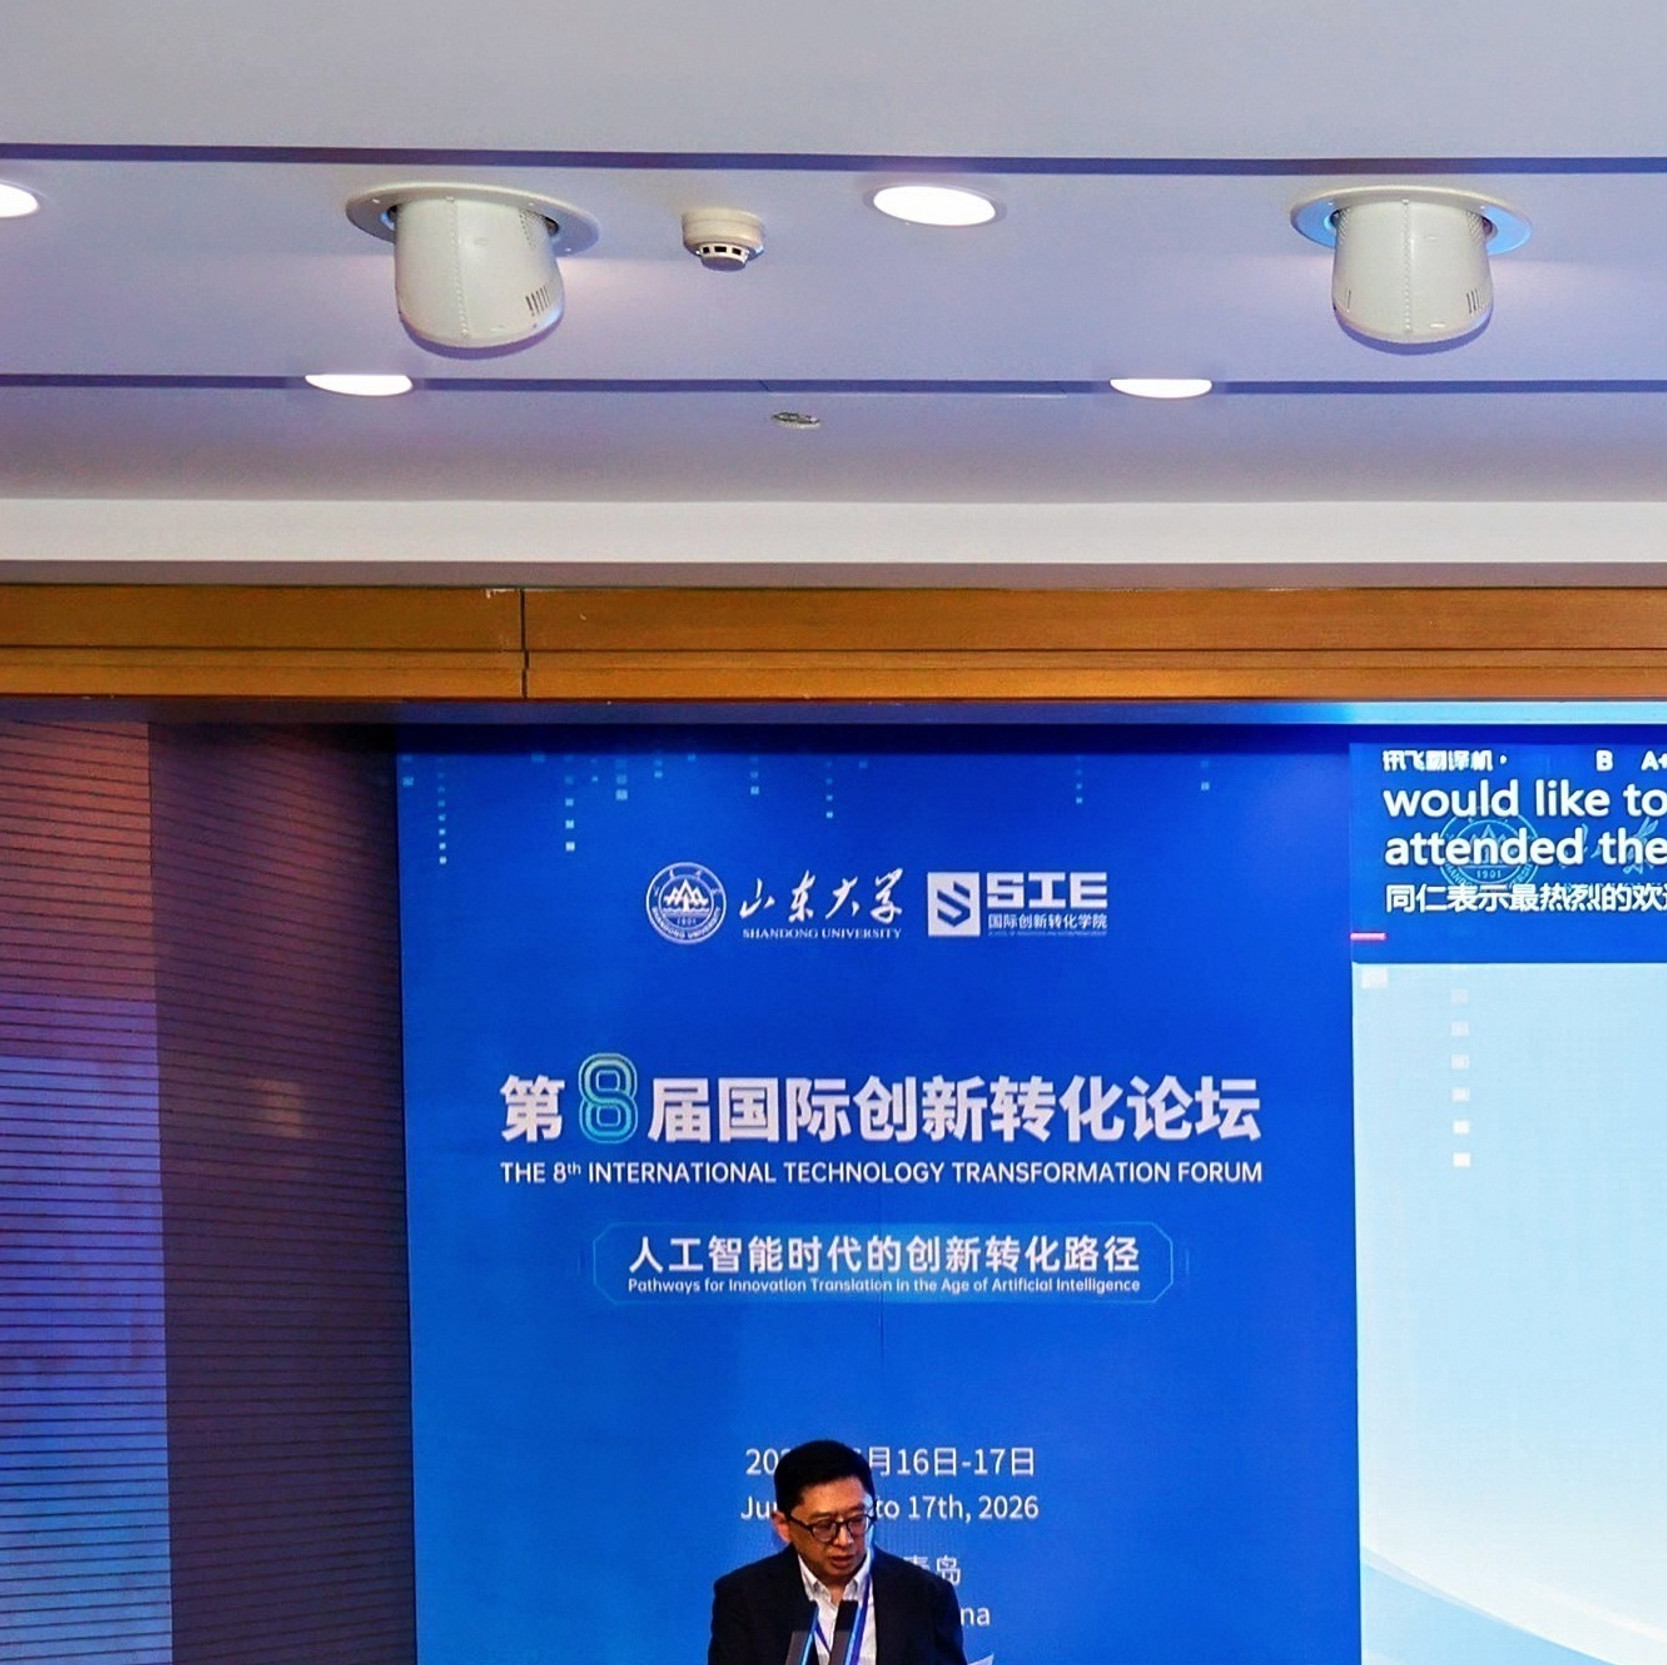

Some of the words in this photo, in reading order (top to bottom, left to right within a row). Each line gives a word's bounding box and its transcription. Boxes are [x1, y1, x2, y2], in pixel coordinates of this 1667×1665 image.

[1597, 750, 1613, 771] B
[1384, 780, 1517, 816] would
[1537, 781, 1609, 815] like
[1386, 828, 1582, 864] attended
[987, 873, 1107, 908] SIE
[989, 914, 1107, 928] 国际创新转化学院
[743, 928, 818, 939] SHANDONG
[822, 928, 901, 939] UNIVERSITY
[501, 1163, 544, 1182] THE
[554, 1163, 580, 1182] 8th
[589, 1163, 776, 1182] INTERNATIONAL
[784, 1162, 944, 1182] TECHNOLOGY
[952, 1162, 1170, 1182] TRANSFORMATION
[1179, 1162, 1261, 1182] FORUM
[630, 1236, 1138, 1272] 人工智能时代的创新转化路径
[628, 1279, 700, 1294] Pathways
[705, 1279, 723, 1291] for
[729, 1279, 807, 1291] Innovation
[811, 1279, 893, 1291] Translation
[897, 1279, 910, 1291] in
[914, 1279, 938, 1291] the
[942, 1279, 970, 1294] Age
[973, 1279, 988, 1291] of
[992, 1279, 1053, 1291] Artificial
[1056, 1279, 1140, 1294] Intelligence
[741, 1496, 777, 1520] Ju
[876, 1497, 899, 1519] to
[908, 1495, 972, 1523] 17th,
[978, 1496, 1039, 1520] 2026
